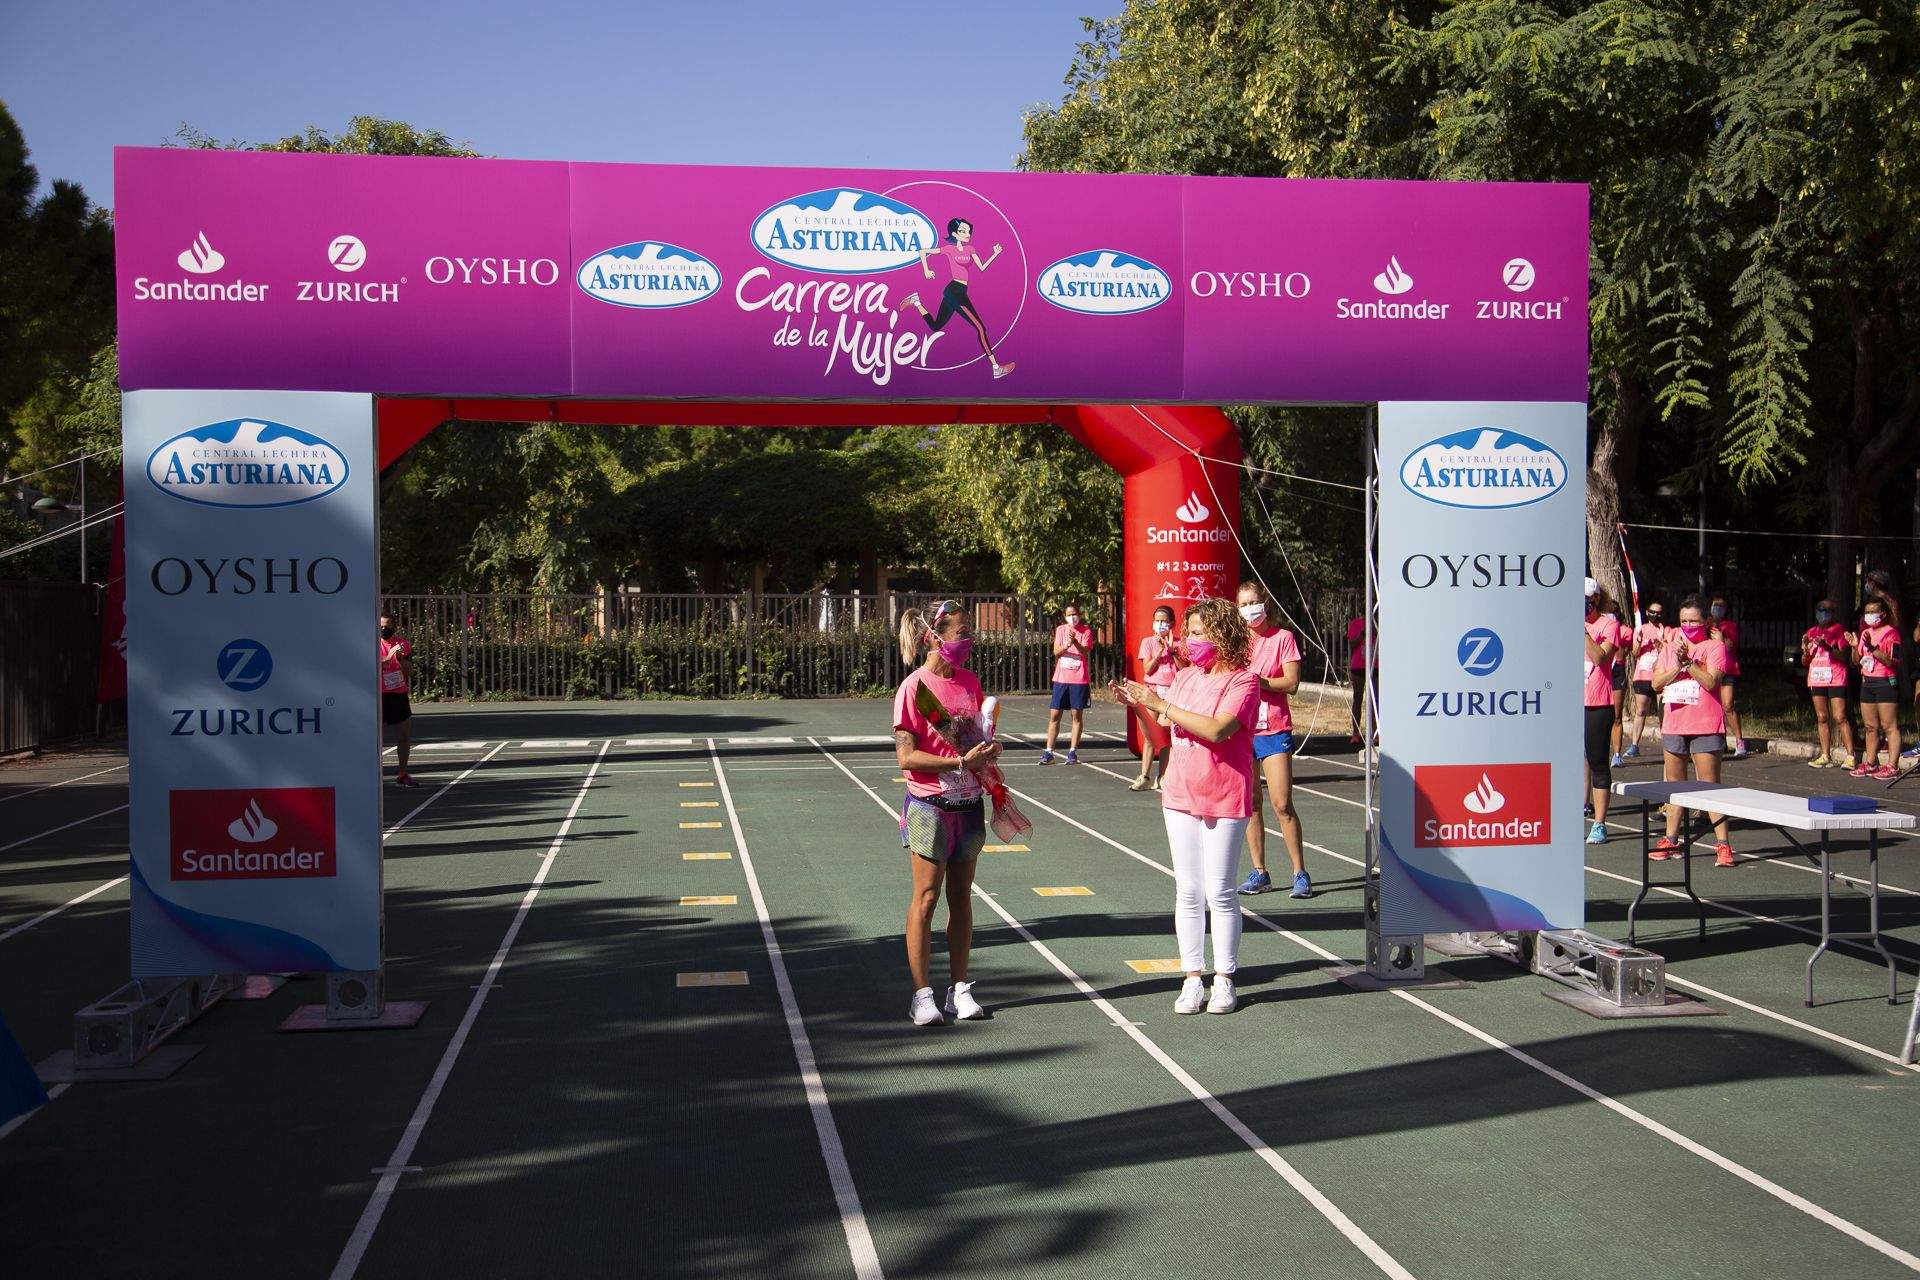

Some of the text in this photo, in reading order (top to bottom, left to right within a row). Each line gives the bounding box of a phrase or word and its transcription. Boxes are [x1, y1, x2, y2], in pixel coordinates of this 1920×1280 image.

[766, 217, 922, 252] ASTURIANA
[794, 215, 918, 228] CENTRAL LECHERA
[424, 256, 560, 286] OYSHO
[588, 264, 710, 291] ASTURIANA
[610, 263, 706, 273] CENTRAL LECHERA
[1068, 271, 1158, 281] CENTRAL LECHERA
[134, 277, 269, 302] Santander
[296, 281, 399, 304] ZURICH
[735, 266, 890, 315] Carrera
[1048, 272, 1162, 299] ASTURIANA
[1190, 271, 1311, 299] OYSHO
[1336, 298, 1450, 321] Santander
[1475, 301, 1562, 321] ZURICH
[773, 310, 946, 386] de la Mujer
[192, 449, 328, 459] CENTRAL LECHERA
[1440, 455, 1552, 464] CENTRAL LECHERA
[162, 451, 335, 485] ASTURIANA
[1413, 457, 1557, 488] ASTURIANA
[1146, 527, 1231, 544] Santander
[151, 556, 349, 596] OYSHO
[1172, 561, 1180, 572] 2
[1182, 560, 1190, 571] 3
[1197, 563, 1225, 571] correr
[1401, 553, 1566, 589] OYSHO
[1416, 691, 1542, 717] ZURICH
[170, 708, 323, 737] ZURICH
[953, 773, 969, 784] 016
[1424, 818, 1542, 842] Santander
[181, 848, 325, 874] Santander
